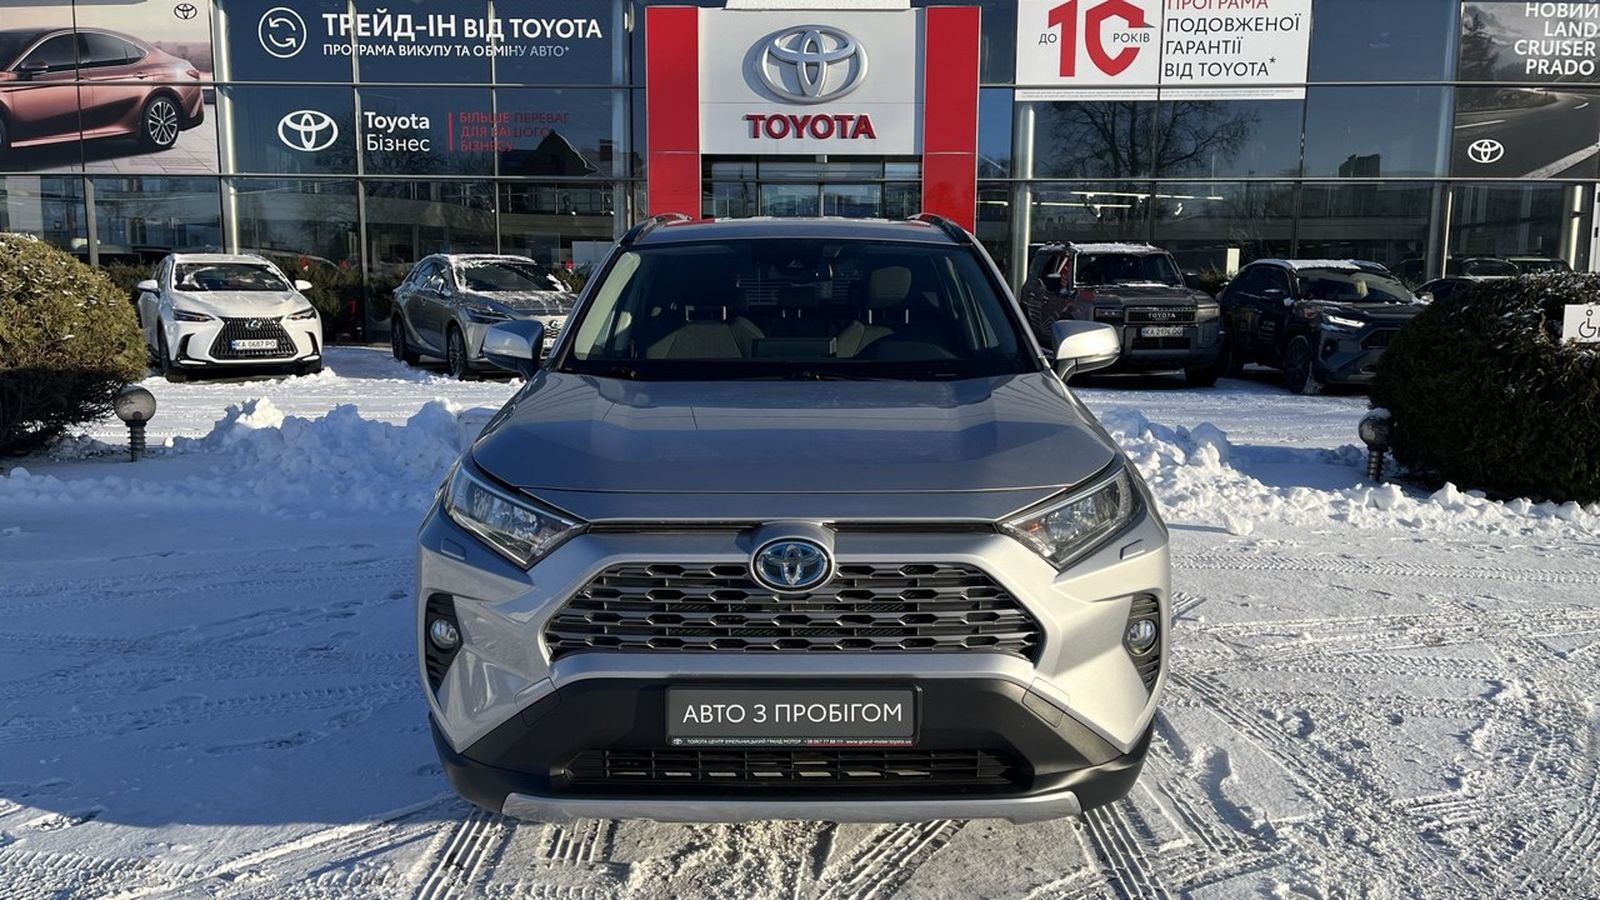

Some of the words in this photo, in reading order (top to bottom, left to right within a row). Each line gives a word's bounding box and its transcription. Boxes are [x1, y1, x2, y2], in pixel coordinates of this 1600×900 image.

[322, 8, 456, 42] ТРЕЙД-ІН
[464, 18, 505, 42] ВІД
[509, 18, 603, 39] TOYOTA
[1166, 13, 1302, 35] ПОДОВЖЕНОЇ
[1544, 21, 1598, 37] LAND
[1038, 33, 1058, 45] ДО
[1112, 33, 1150, 43] РОКІВ
[1165, 36, 1244, 55] ГАРАНТІЇ
[1514, 39, 1596, 57] CRUISER
[323, 43, 396, 57] ПРОГРАМА
[398, 44, 452, 57] ВИКУПУ
[454, 44, 471, 57] ТА
[473, 44, 527, 57] ОБМІНУ
[1164, 62, 1193, 80] ВІД
[1525, 58, 1595, 76] PRADO
[364, 111, 430, 133] Toyota
[745, 114, 876, 140] TOYOTA
[367, 133, 430, 152] Бізнес
[682, 704, 746, 724] АВТО
[775, 703, 902, 722] ПРОБІГОМ
